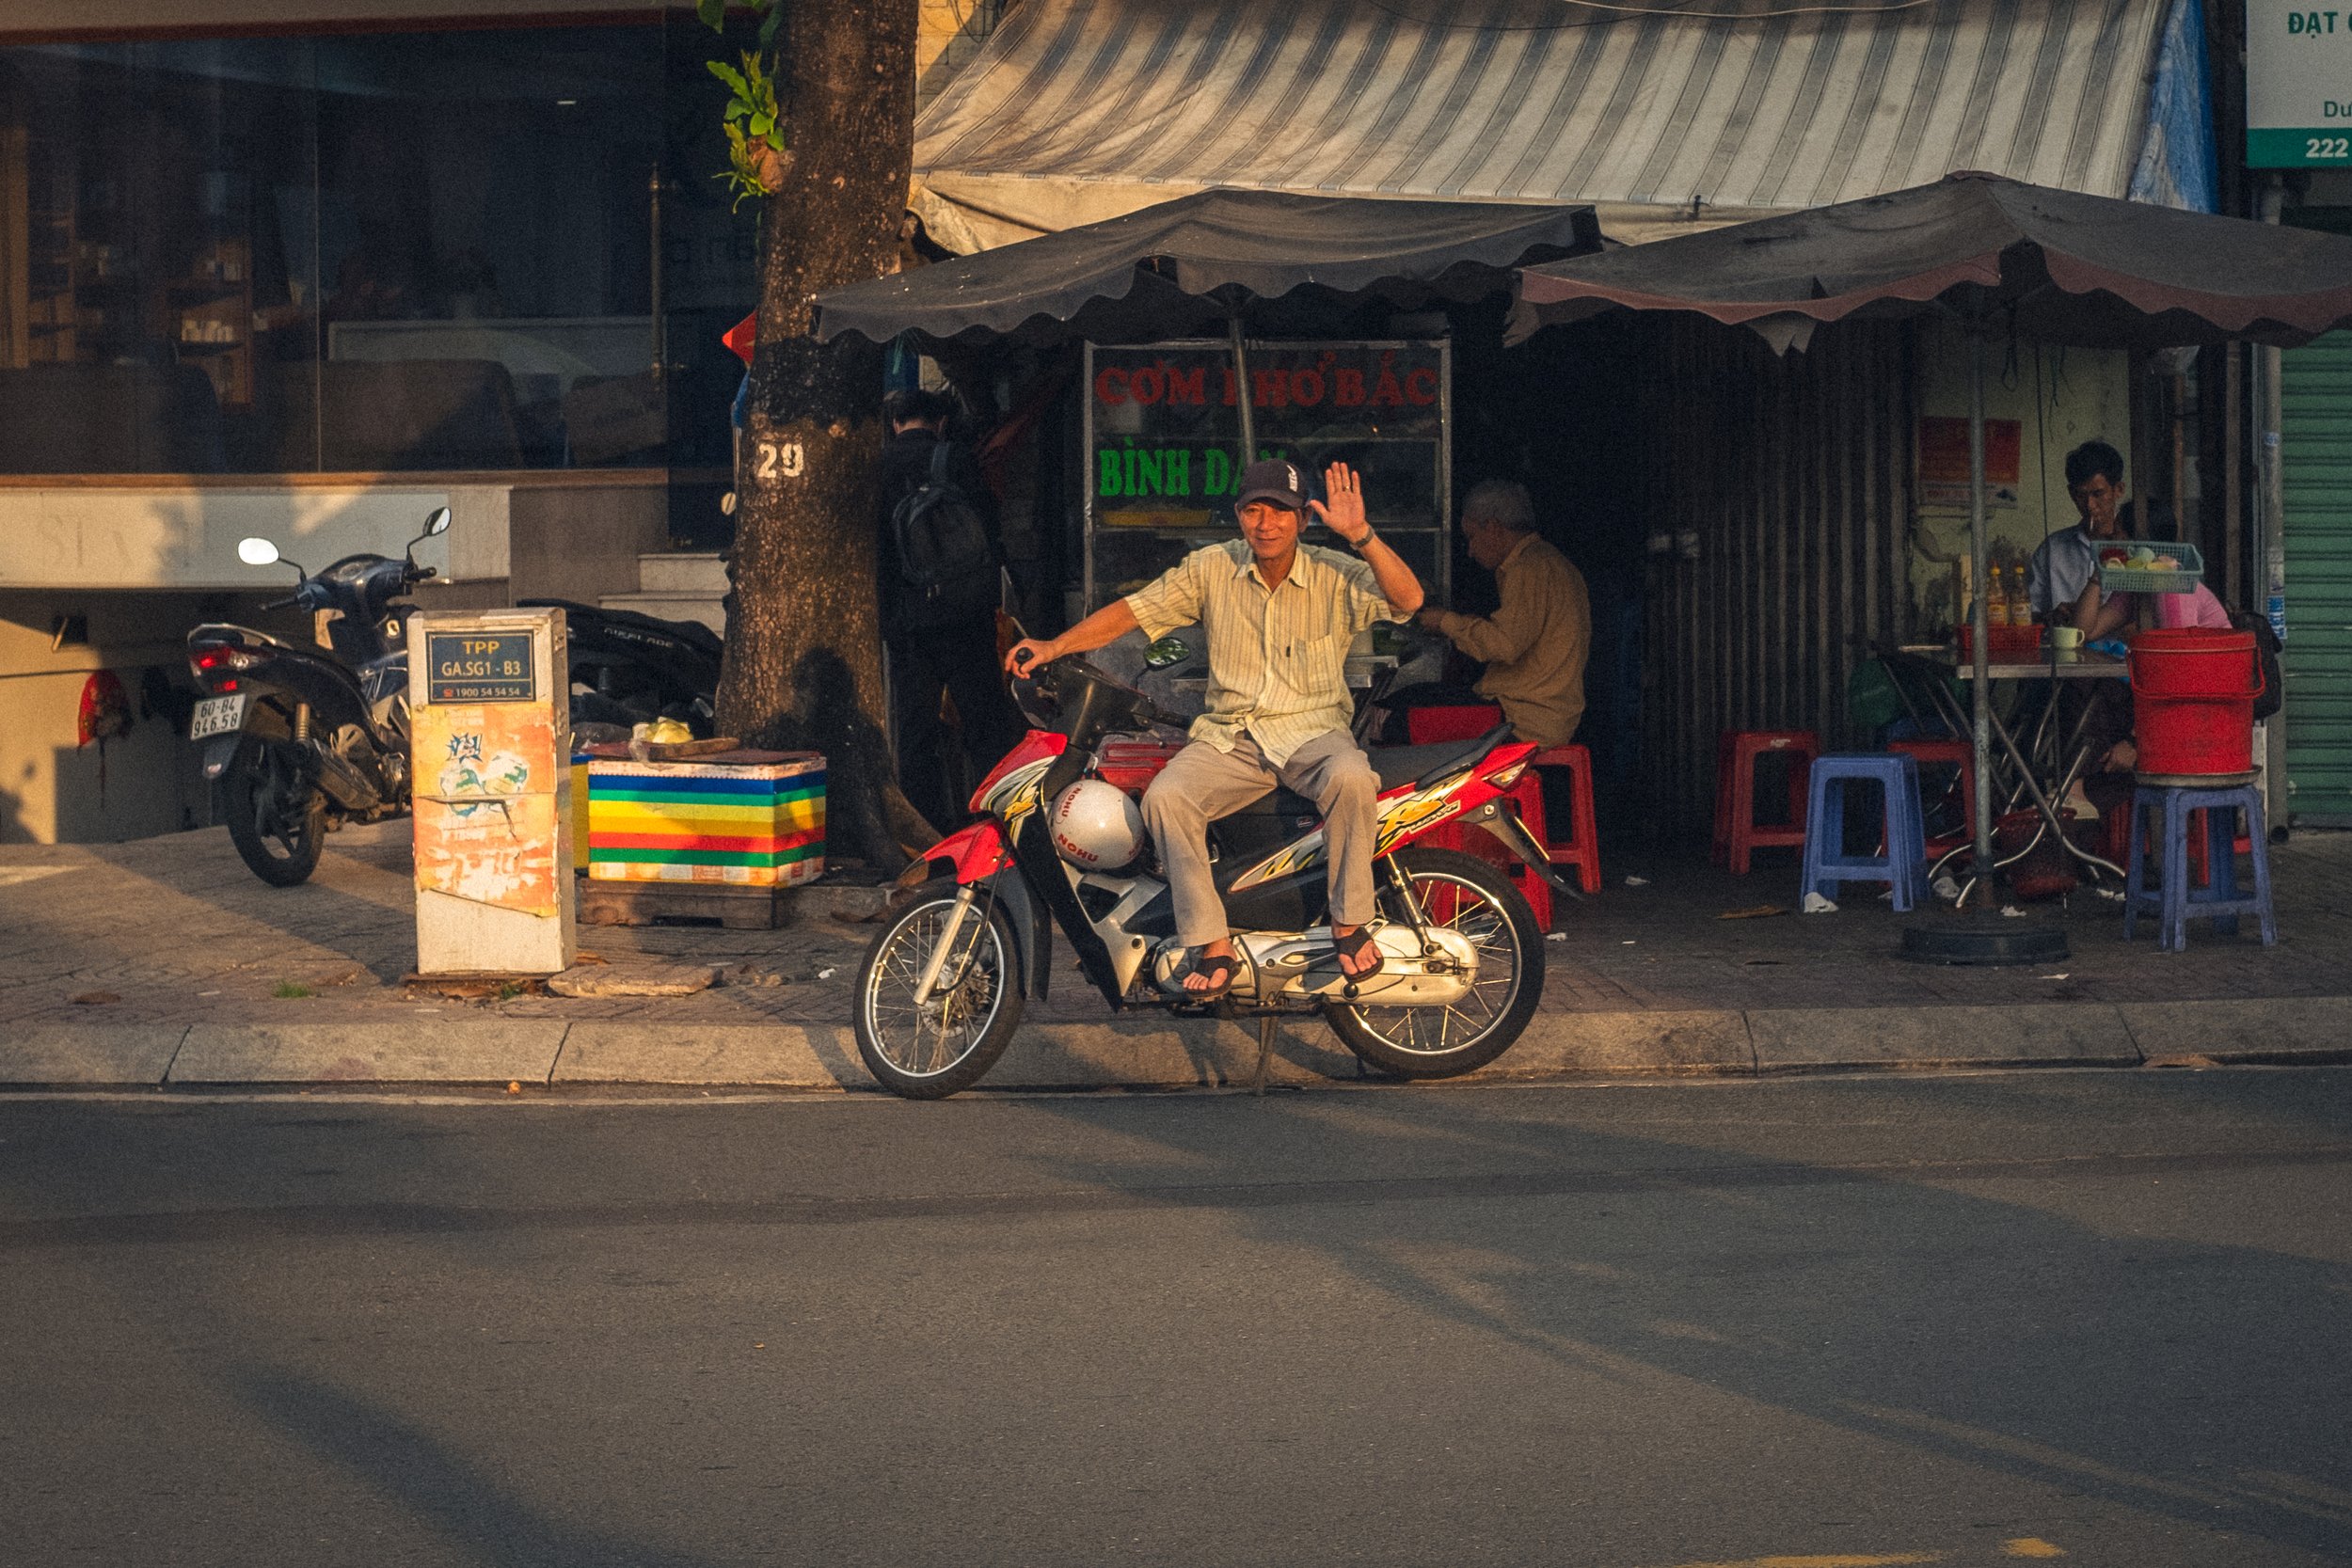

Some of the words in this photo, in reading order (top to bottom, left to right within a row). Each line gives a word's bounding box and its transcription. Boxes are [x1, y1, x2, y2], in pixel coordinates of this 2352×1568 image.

[2306, 137, 2348, 158] 222
[1095, 359, 1205, 405] CƠM
[757, 443, 804, 479] 29
[1099, 436, 1190, 497] BÌNH
[462, 641, 500, 655] TPP
[441, 661, 491, 676] GA.SG1
[503, 660, 520, 675] B3
[455, 688, 479, 697] 1900
[481, 688, 492, 697] 54
[494, 687, 506, 697] 54
[508, 687, 519, 696] 54
[194, 712, 238, 736] 946.58
[1057, 832, 1099, 862] NOHU
